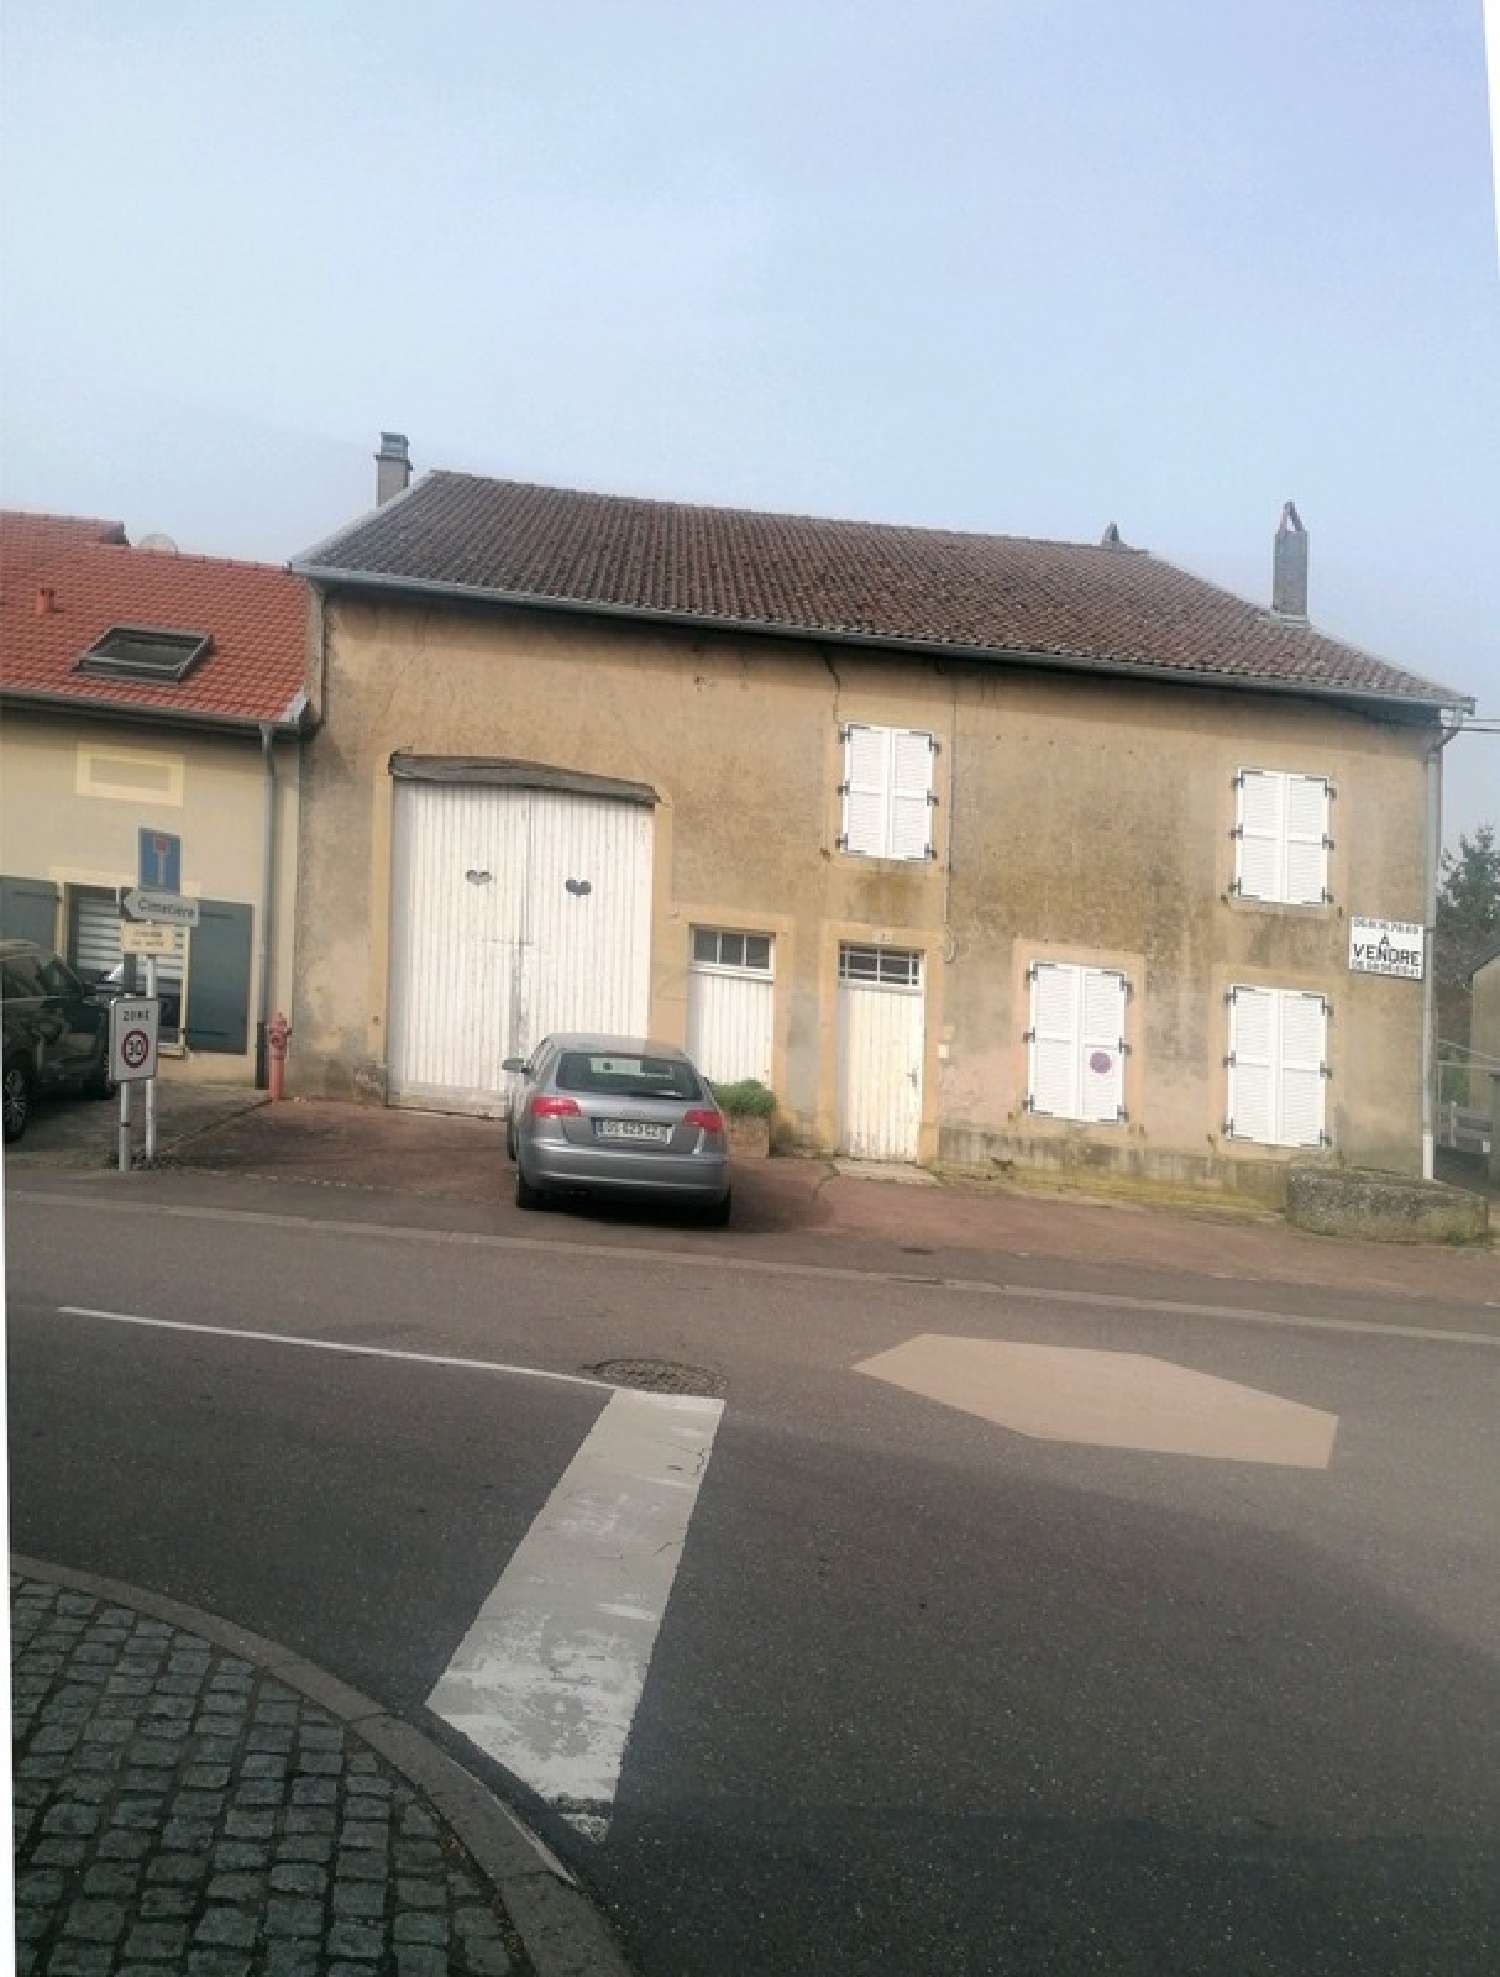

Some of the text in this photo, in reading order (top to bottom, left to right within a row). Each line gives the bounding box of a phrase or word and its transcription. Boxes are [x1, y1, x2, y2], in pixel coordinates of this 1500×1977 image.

[1353, 943, 1421, 966] VENDRE
[123, 1009, 150, 1021] ZONE
[128, 1040, 142, 1056] 30
